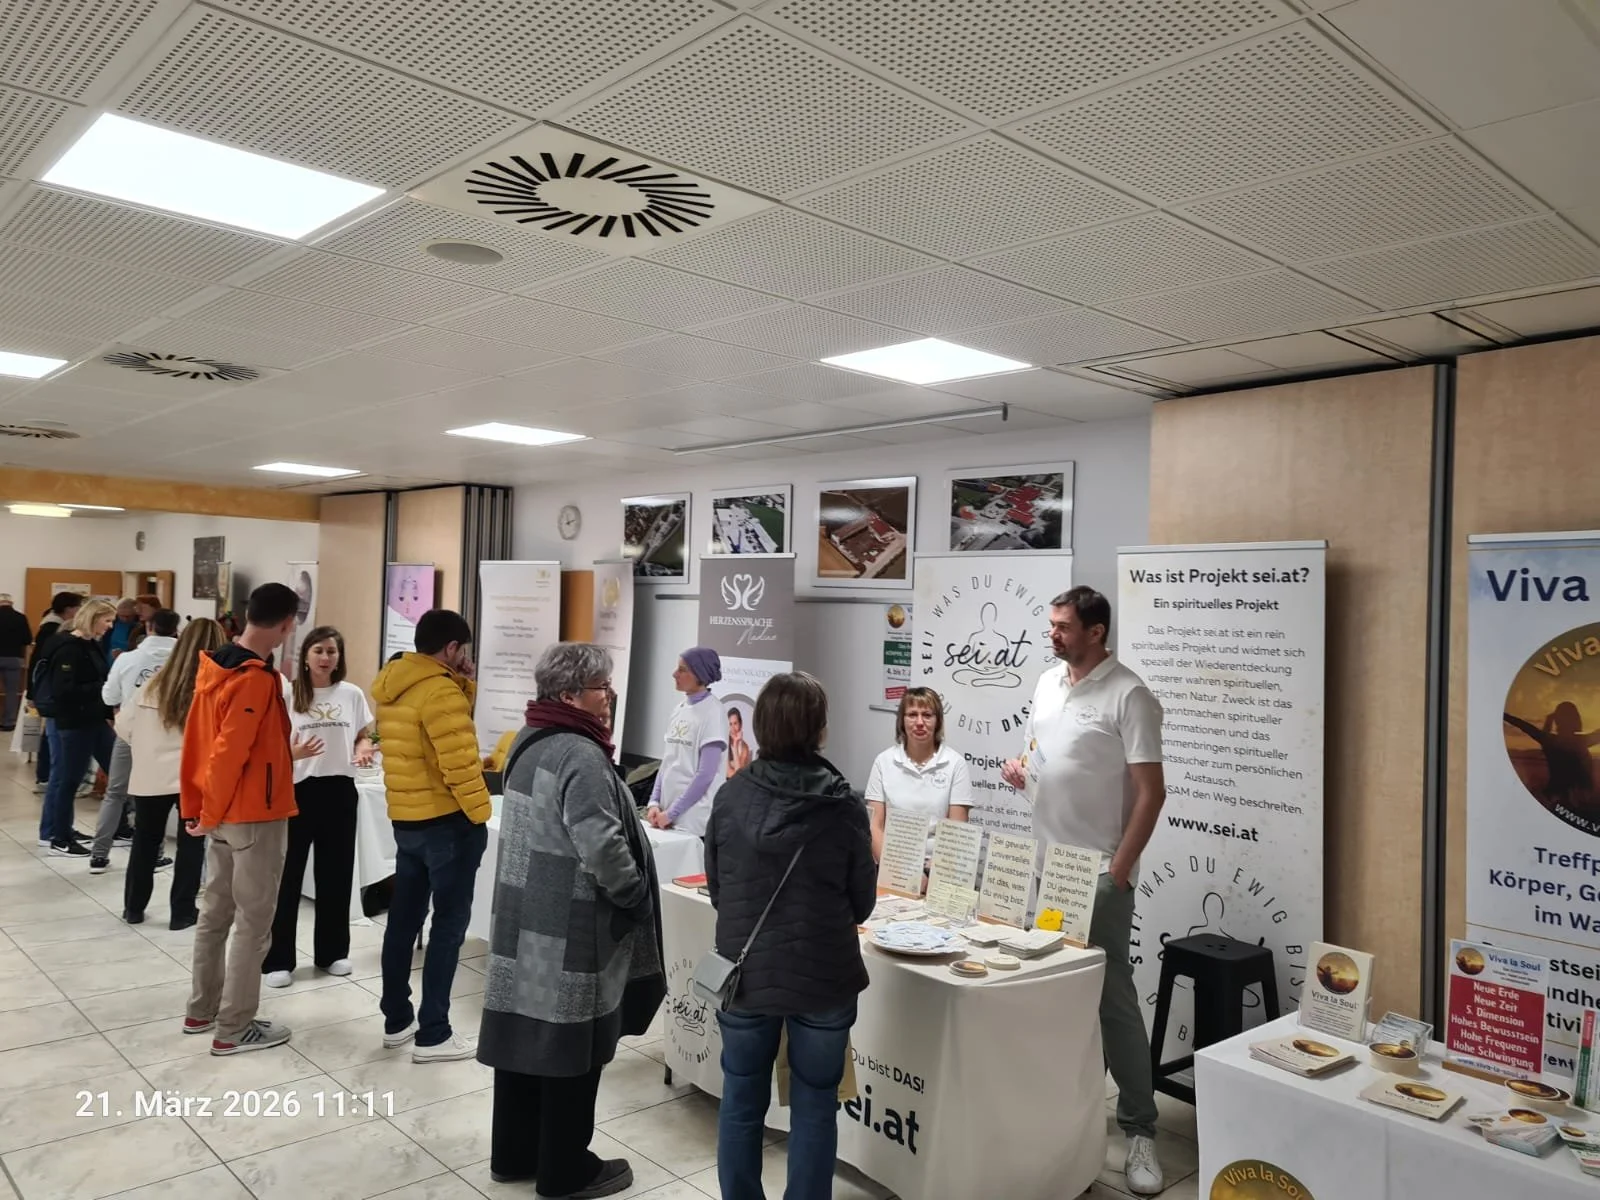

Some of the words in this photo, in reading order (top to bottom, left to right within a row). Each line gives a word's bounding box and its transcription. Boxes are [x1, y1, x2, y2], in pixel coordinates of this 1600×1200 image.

[1130, 569, 1162, 583] Was
[1166, 569, 1184, 583] ist
[1189, 569, 1248, 587] Projekt
[1253, 567, 1309, 583] sei.at?
[1487, 567, 1590, 602] Viva
[1154, 598, 1169, 609] Ein
[1172, 599, 1232, 611] spirituelles
[1236, 599, 1279, 612] Projekt
[710, 616, 773, 627] HERZENSSPRACHE
[932, 586, 961, 618] WAS
[971, 574, 992, 590] DU
[1004, 578, 1044, 617] EWIG
[1041, 629, 1056, 664] BIS
[1148, 625, 1164, 635] Das
[1167, 626, 1201, 638] Projekt
[1203, 629, 1229, 638] sei.at
[1232, 629, 1244, 638] ist
[1247, 630, 1262, 639] ein
[1265, 631, 1285, 639] rein
[944, 629, 1032, 668] sei.at
[1132, 641, 1180, 652] spirituelles
[1182, 643, 1218, 655] Projekt
[1219, 644, 1239, 654] und
[1242, 646, 1280, 656] widmet
[1284, 648, 1305, 658] sich
[1534, 636, 1600, 678] Viva
[1141, 657, 1174, 668] speziell
[1176, 658, 1192, 668] der
[1195, 659, 1292, 676] Wiederentdeckung
[1148, 674, 1182, 684] unserer
[1186, 676, 1220, 686] wahren
[1223, 679, 1283, 692] spirituellen,
[1222, 694, 1255, 706] Zweck
[1258, 697, 1270, 707] ist
[1273, 698, 1293, 709] das
[958, 714, 992, 736] BIST
[1001, 700, 1032, 733] DAS
[1163, 707, 1225, 719] anntmachen
[1227, 711, 1282, 725] spiritueller
[1162, 723, 1226, 737] nformationen
[1229, 727, 1249, 738] und
[1252, 730, 1271, 741] das
[1233, 744, 1288, 760] spiritueller
[1184, 771, 1237, 787] Austausch.
[1211, 761, 1233, 771] zum
[1235, 762, 1303, 780] persönlichen
[972, 780, 996, 790] uelles
[998, 782, 1016, 795] Proj
[1192, 790, 1211, 801] den
[1213, 792, 1237, 807] Weg
[1239, 796, 1304, 815] beschreiten.
[1168, 816, 1259, 842] www.sei.at
[988, 862, 1029, 878] Bewusstsein
[1139, 862, 1175, 898] WAS
[1189, 855, 1215, 873] DU
[1232, 867, 1288, 924] EWIG
[1489, 868, 1572, 901] Körper,
[1535, 905, 1562, 926] im
[1488, 953, 1509, 965] Viva
[1510, 958, 1519, 967] la
[1520, 961, 1541, 971] Soul
[1549, 959, 1600, 981] stsei
[1311, 989, 1329, 1001] Viva
[1330, 996, 1338, 1004] la
[1340, 998, 1357, 1010] Soul
[1473, 982, 1496, 995] Neue
[1498, 987, 1519, 1000] Erde
[1474, 994, 1496, 1008] Neue
[1499, 1000, 1518, 1013] Zeit
[1476, 1007, 1524, 1027] Dimension
[1547, 1013, 1581, 1034] tivi
[1451, 1014, 1478, 1029] Hohes
[1480, 1021, 1540, 1044] Bewusstsein
[1461, 1028, 1483, 1043] Hohe
[1485, 1036, 1528, 1054] Frequenz
[1453, 1039, 1475, 1054] Hohe
[1478, 1046, 1535, 1071] Schwingung
[868, 1056, 890, 1078] bist
[893, 1066, 925, 1094] DAS!
[838, 1085, 919, 1154] ei.at
[1224, 1167, 1257, 1186] Viva
[1260, 1164, 1274, 1183] la
